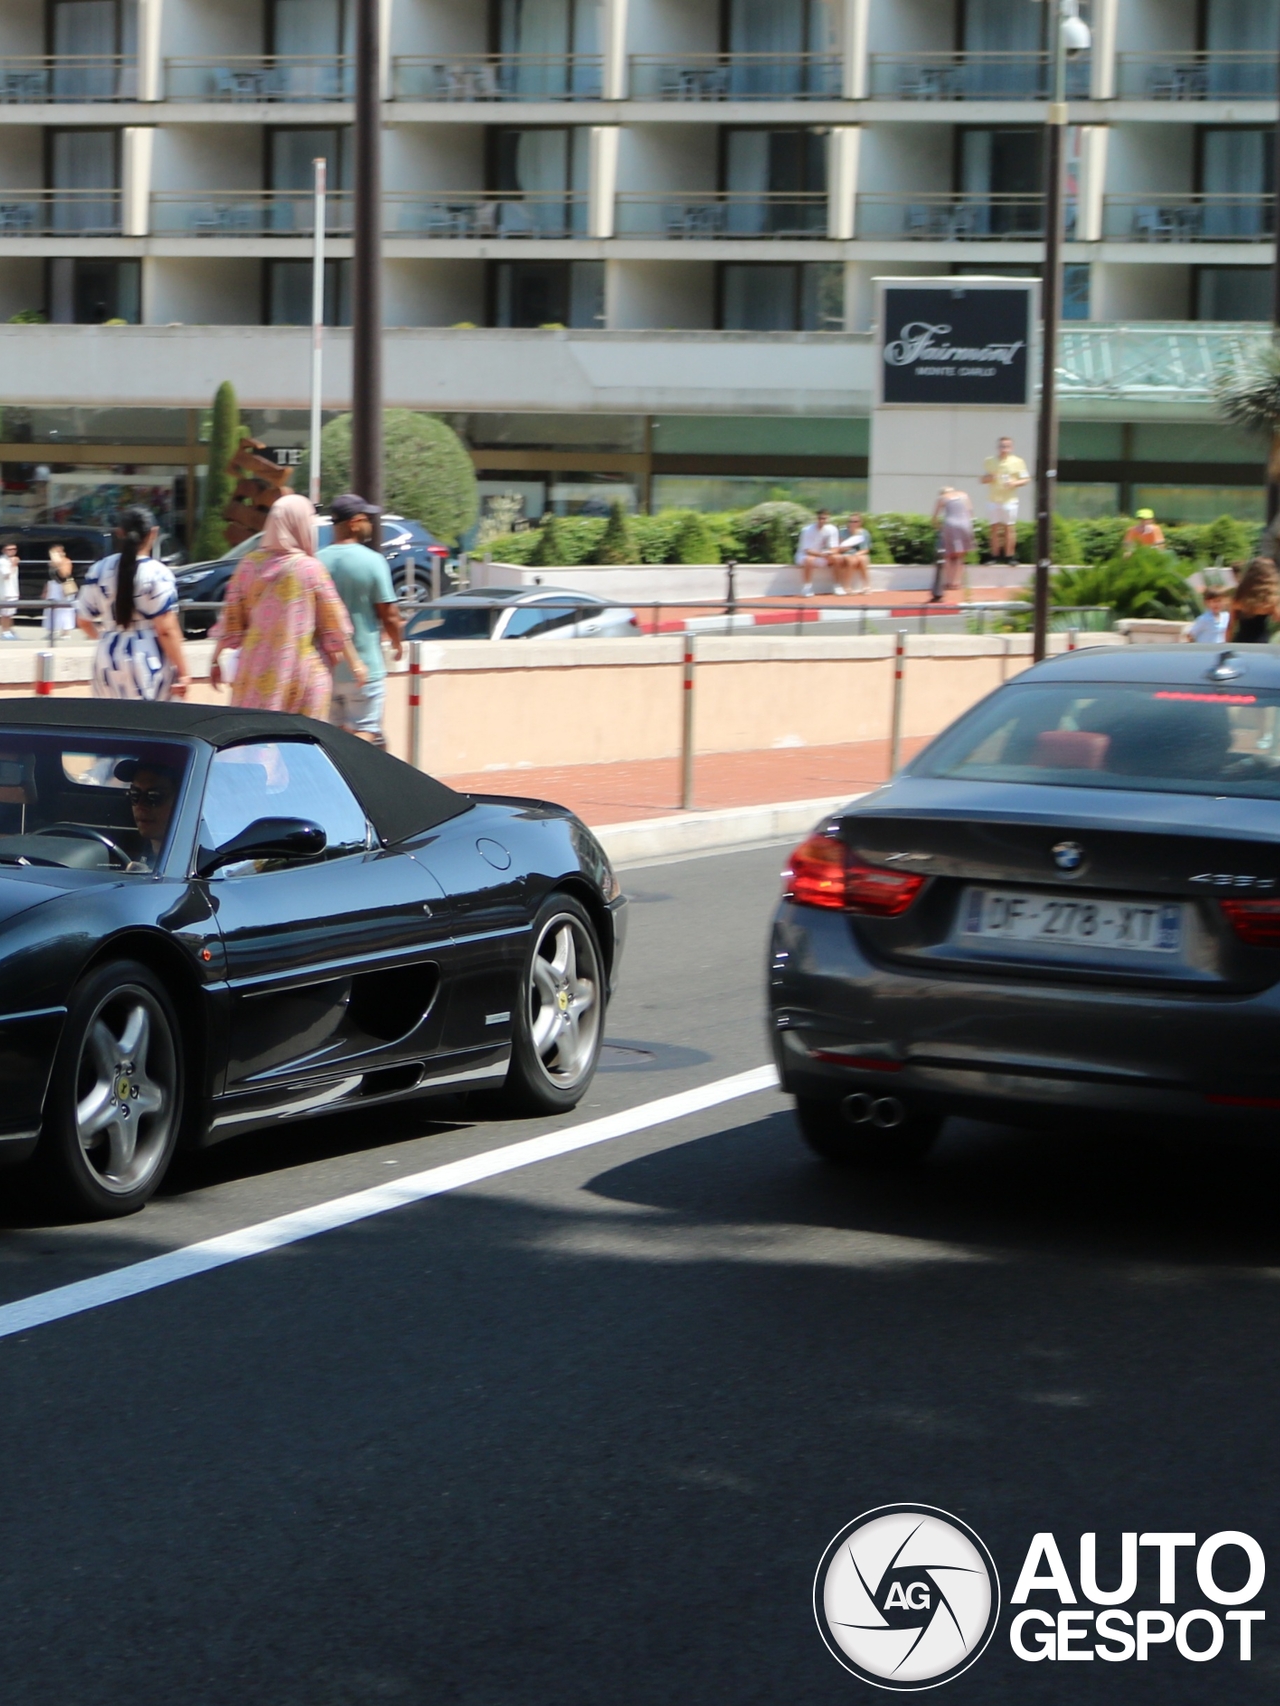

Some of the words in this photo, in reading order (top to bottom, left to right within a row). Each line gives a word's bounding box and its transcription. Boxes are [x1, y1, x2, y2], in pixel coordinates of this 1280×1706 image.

[883, 321, 1027, 366] Fairmont
[915, 366, 956, 376] MONTE
[958, 367, 997, 376] CARLO
